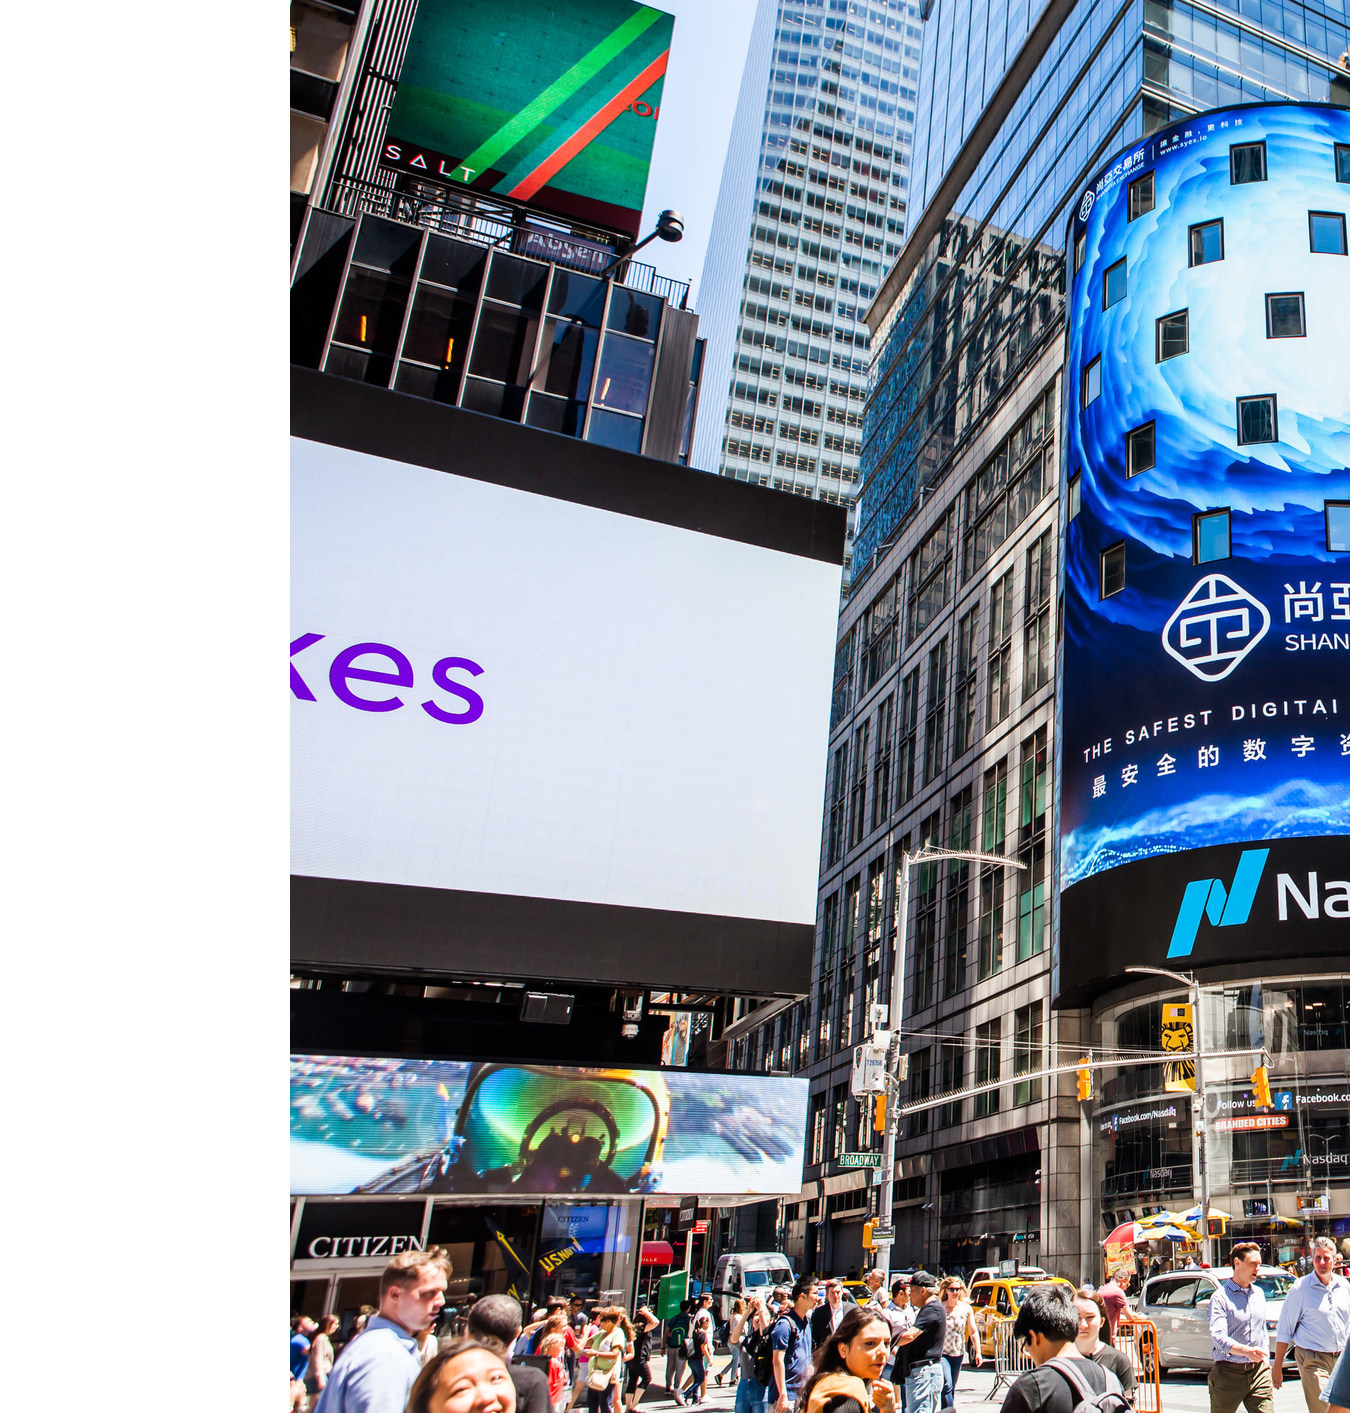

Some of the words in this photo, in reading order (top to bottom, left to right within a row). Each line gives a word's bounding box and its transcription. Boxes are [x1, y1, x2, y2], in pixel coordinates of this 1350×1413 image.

[1160, 135, 1208, 155] www.syex.io
[385, 144, 476, 181] SALT
[1096, 148, 1145, 195] 尚亞交易所
[1083, 738, 1112, 763] THE
[1125, 710, 1212, 745] SAFEST
[1119, 1107, 1177, 1125] Facebook.com/Nasdaq
[1215, 1117, 1254, 1131] BRANDED
[1256, 1116, 1287, 1127] CITIES
[839, 1155, 880, 1166] BROADWAY
[1302, 1153, 1348, 1165] Nasdaq
[309, 1235, 427, 1259] CITIZEN
